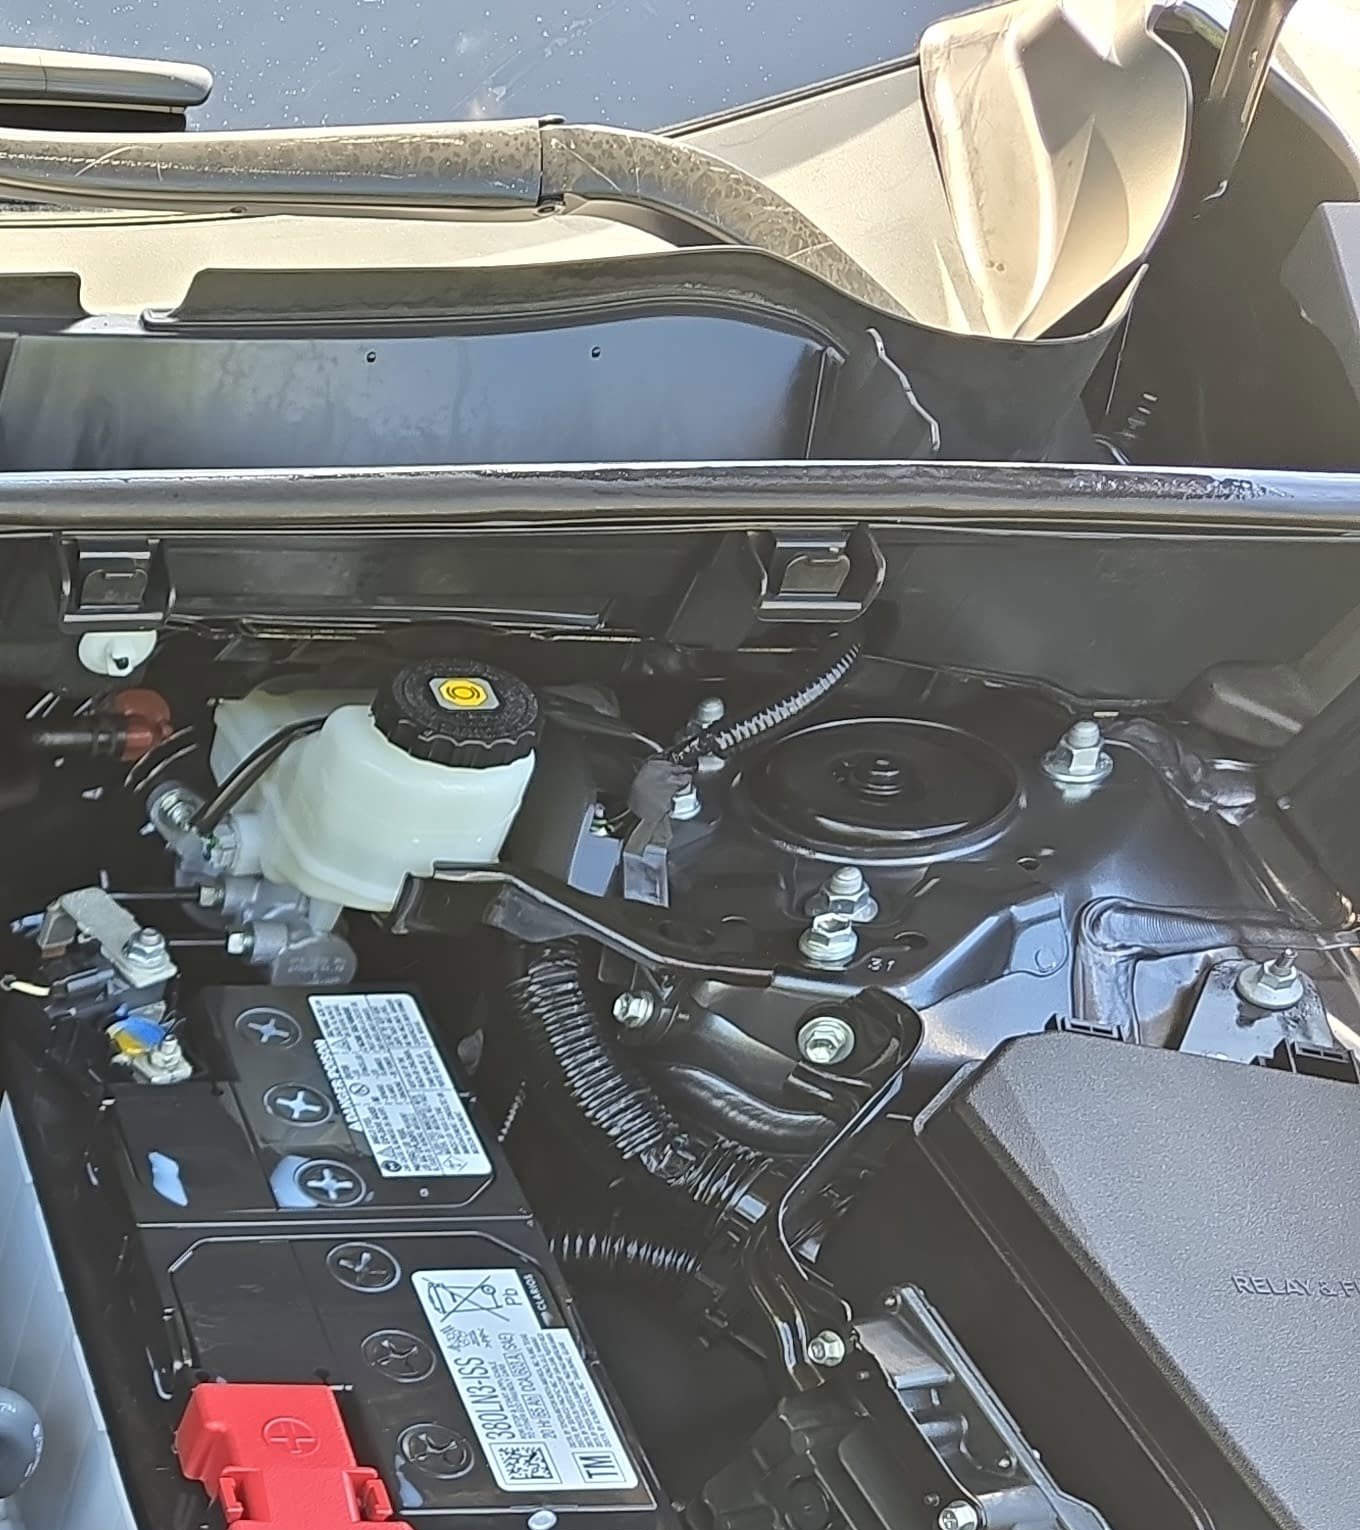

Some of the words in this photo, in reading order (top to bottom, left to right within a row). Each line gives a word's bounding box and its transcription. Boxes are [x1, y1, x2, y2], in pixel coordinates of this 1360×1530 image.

[331, 1079, 357, 1123] DANGER
[502, 1287, 523, 1306] Pb
[524, 1273, 547, 1311] CLARIOS
[1231, 1275, 1312, 1296] RELAY
[1319, 1281, 1337, 1297] &
[1340, 1280, 1360, 1298] F
[454, 1357, 516, 1440] 380LN3-ISS
[580, 1455, 618, 1479] TM
